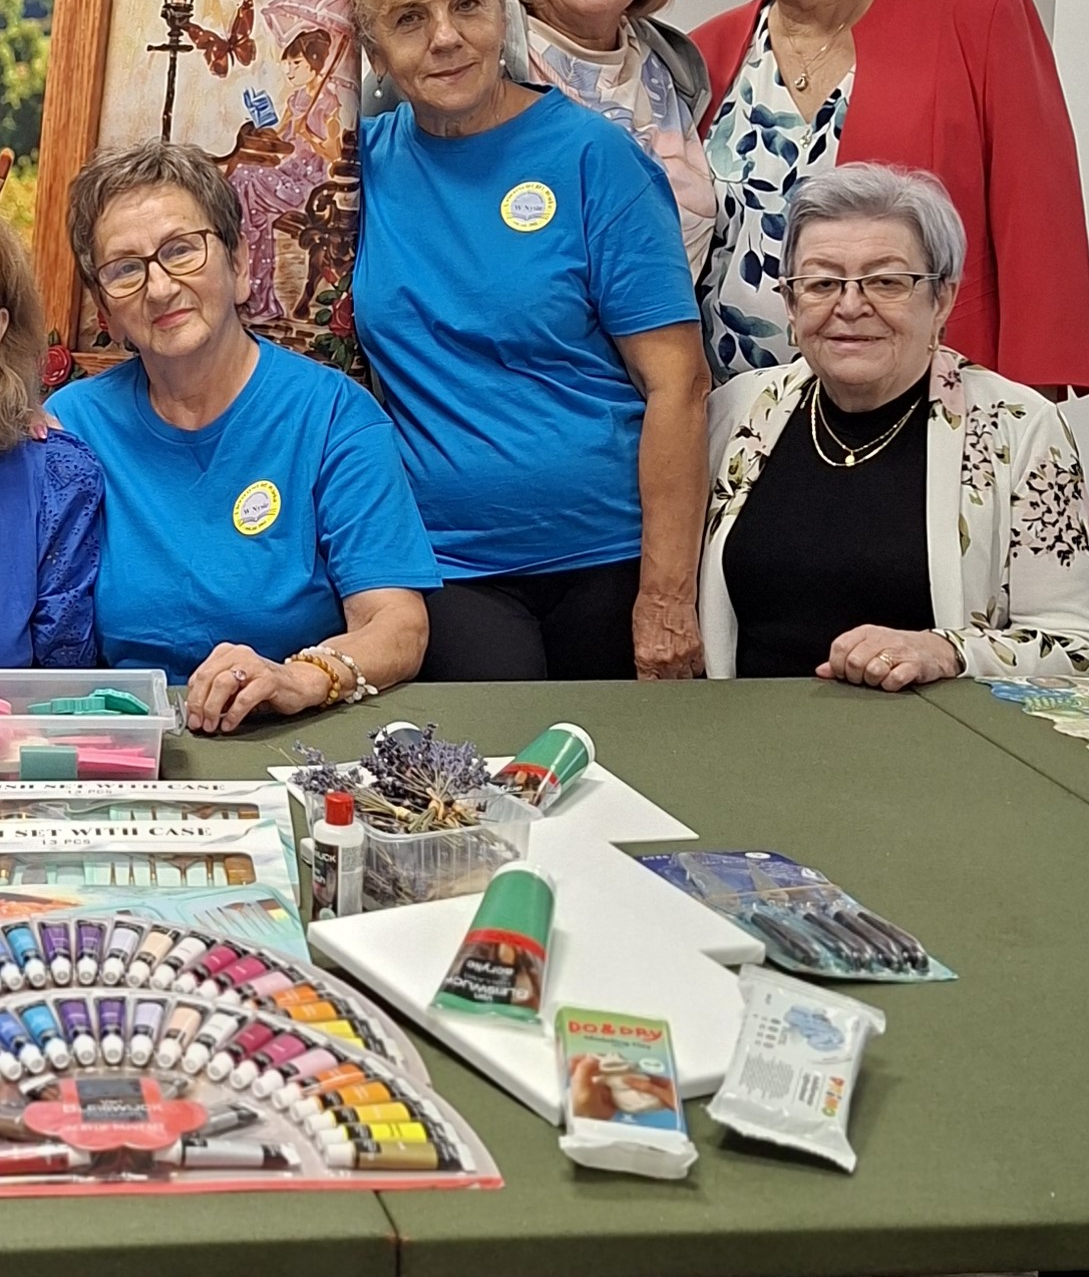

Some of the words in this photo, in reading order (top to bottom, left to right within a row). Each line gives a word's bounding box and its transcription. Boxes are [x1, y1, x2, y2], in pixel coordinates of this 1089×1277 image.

[15, 828, 63, 838] SET
[71, 827, 139, 837] WITH
[149, 827, 213, 837] CASE
